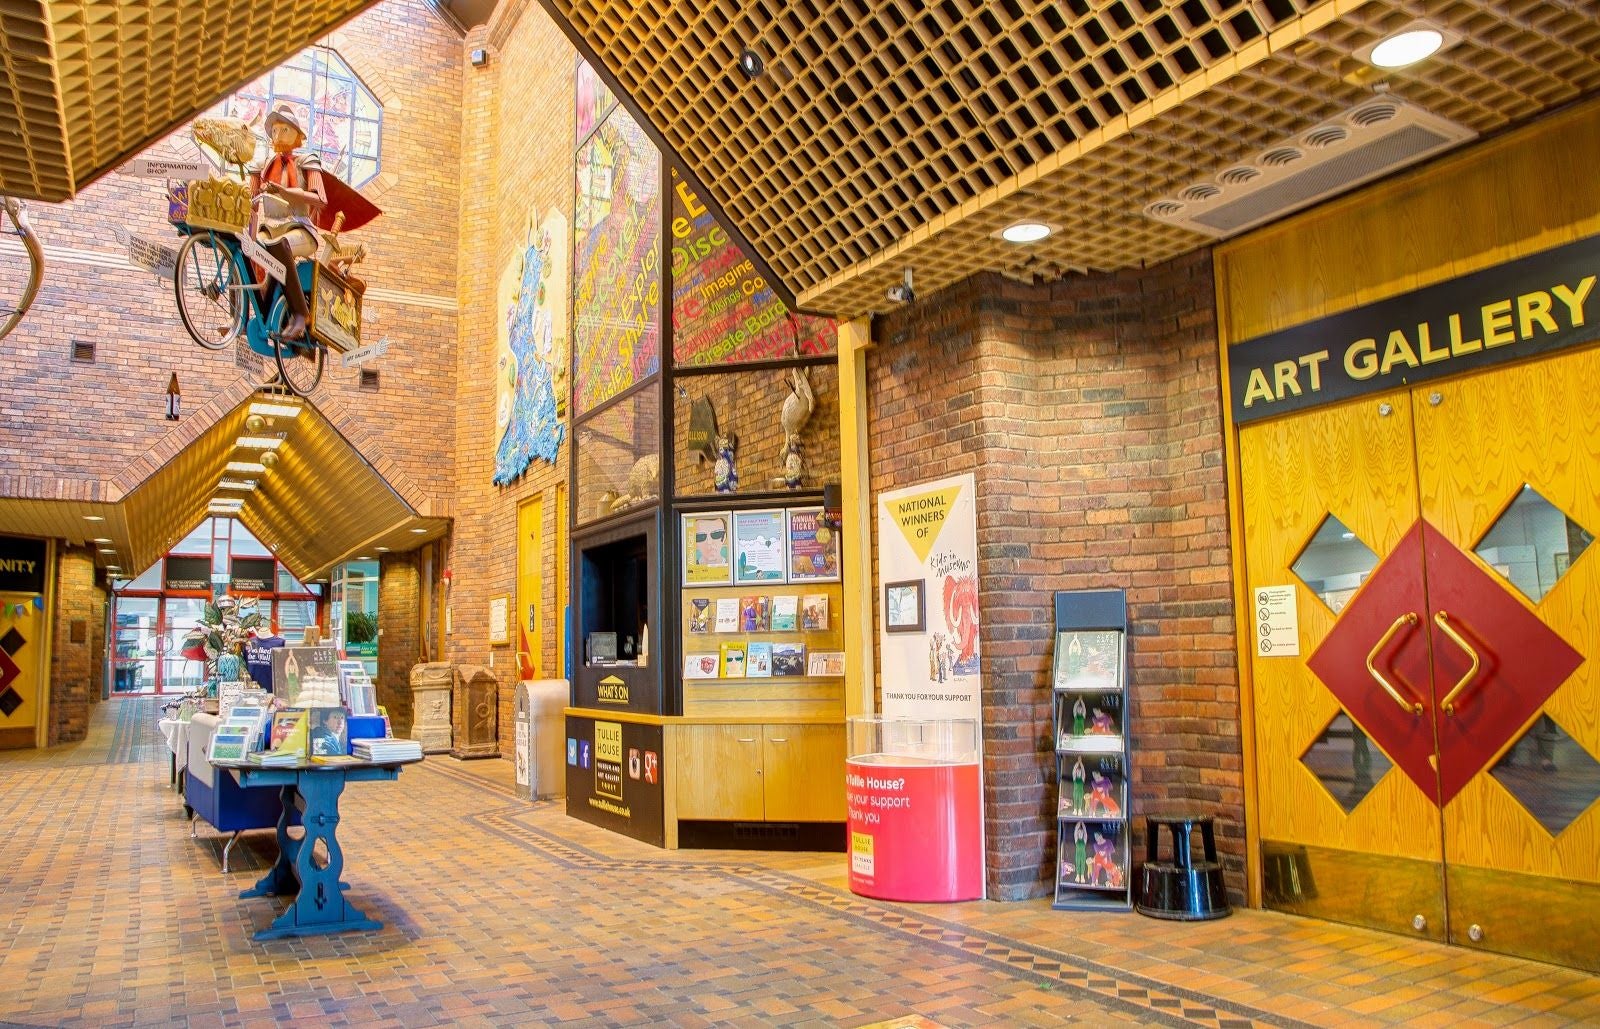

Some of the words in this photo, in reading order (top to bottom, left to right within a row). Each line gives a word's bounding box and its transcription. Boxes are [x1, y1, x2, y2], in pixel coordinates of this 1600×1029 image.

[147, 161, 198, 171] INFORMATION
[255, 250, 274, 269] ENTRANCE
[700, 258, 754, 299] Imagine
[708, 289, 742, 315] Vikings
[695, 329, 746, 366] Create
[1243, 350, 1330, 408] ART
[1343, 275, 1598, 382] GALLERY
[898, 495, 947, 514] NATIONAL
[901, 510, 945, 527] WINNERS
[792, 522, 815, 531] TICKET
[916, 527, 929, 538] OF
[0, 558, 36, 574] NITY
[597, 684, 619, 700] WHAT'S
[618, 686, 629, 700] ON
[886, 692, 904, 700] THANK
[916, 693, 928, 701] FOR
[928, 693, 944, 701] YOUR
[944, 694, 972, 702] SUPPORT
[597, 728, 620, 742] TULLIE
[597, 744, 620, 757] HOUSE
[866, 776, 905, 790] House?
[870, 795, 911, 810] support
[864, 811, 880, 825] you
